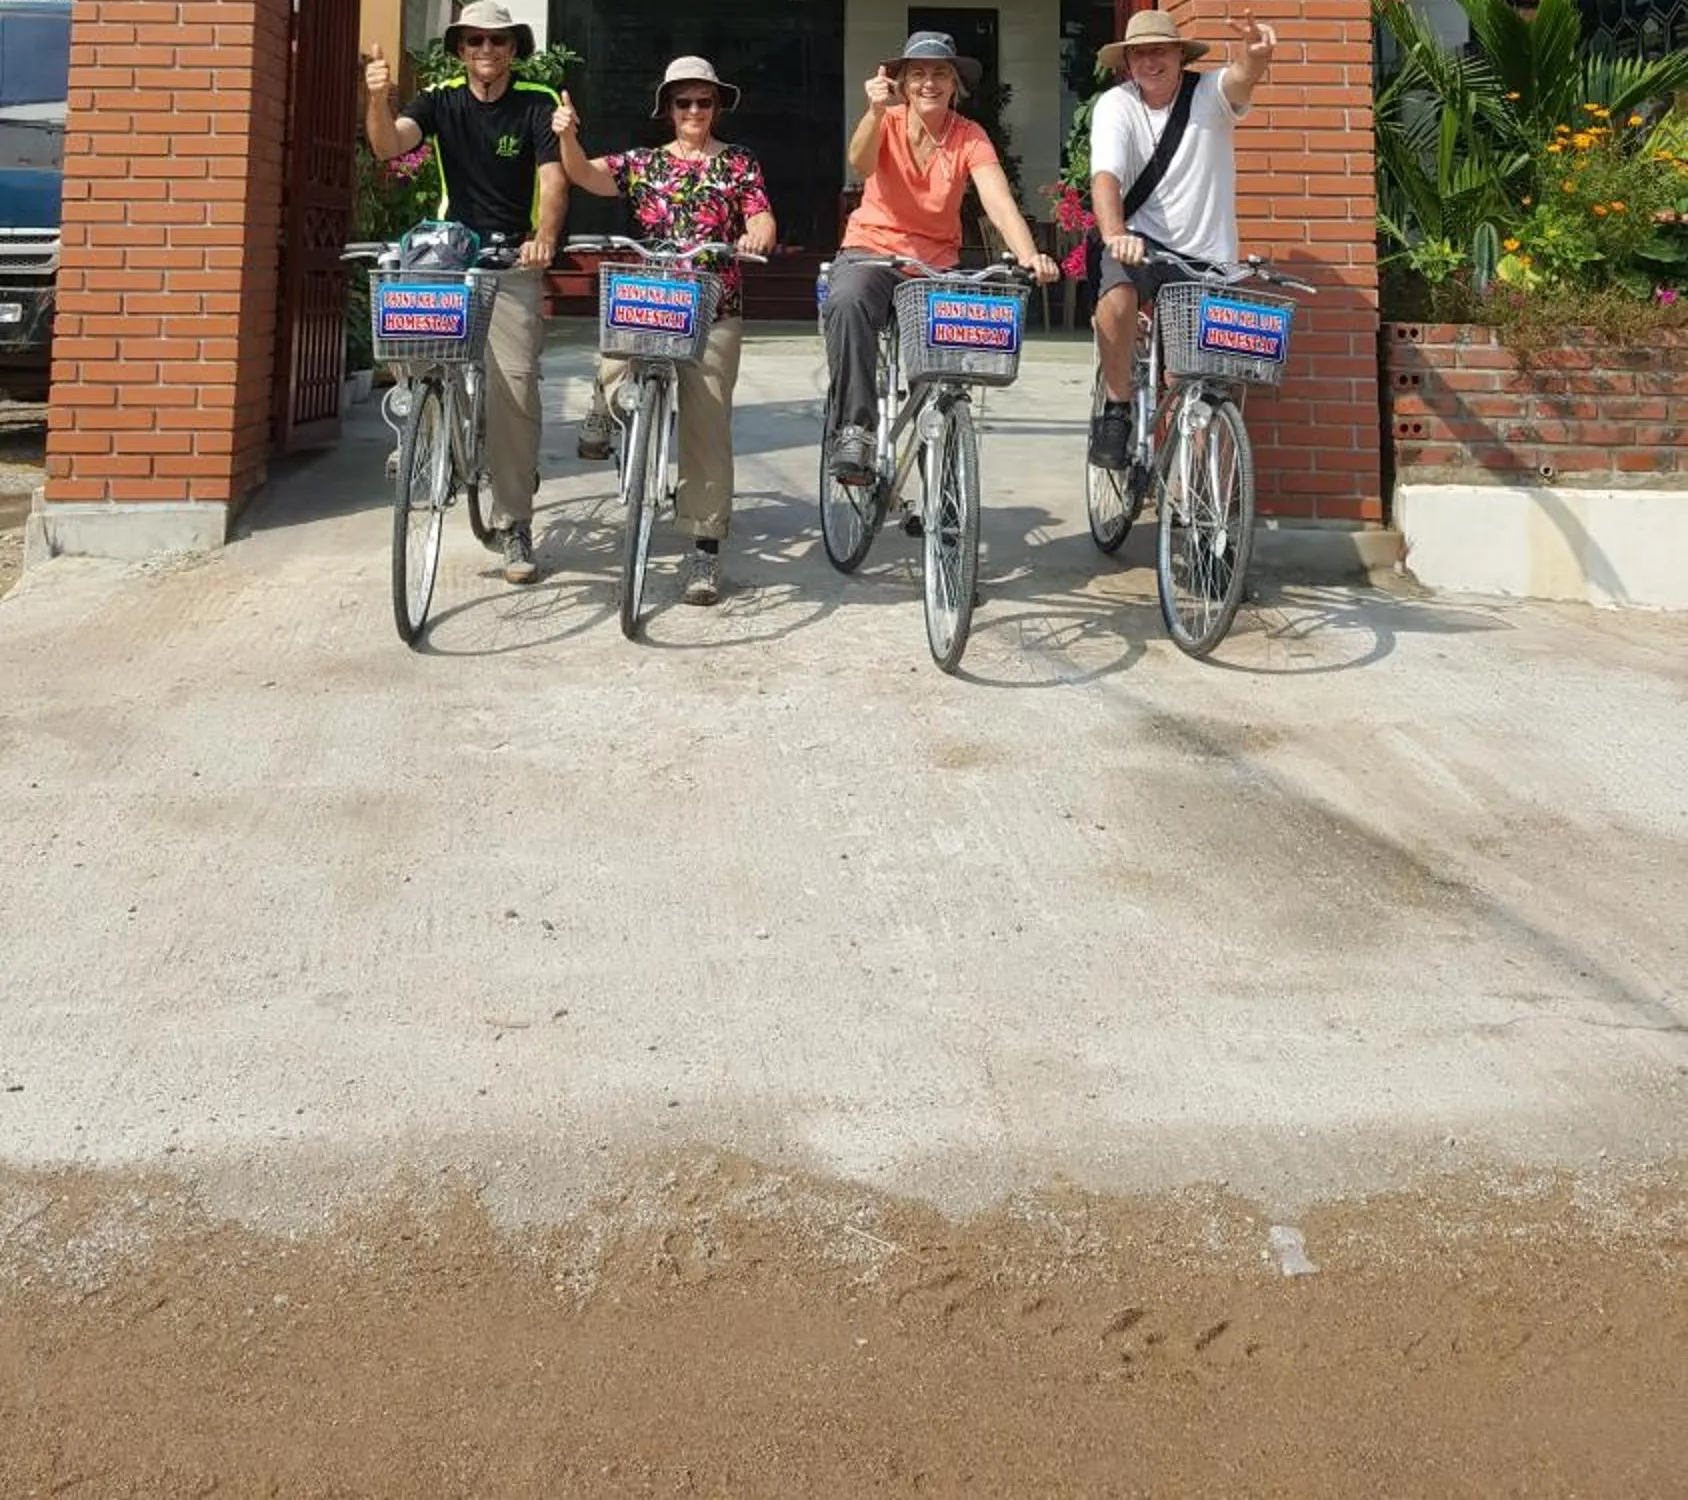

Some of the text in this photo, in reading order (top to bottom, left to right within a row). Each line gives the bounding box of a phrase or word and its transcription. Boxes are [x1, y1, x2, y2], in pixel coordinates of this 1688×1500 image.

[384, 313, 461, 332] HOMESTAY
[615, 304, 687, 328] HOMESTAY
[934, 323, 1011, 346] HOMESTAY
[1206, 327, 1277, 355] HOMESTAY
